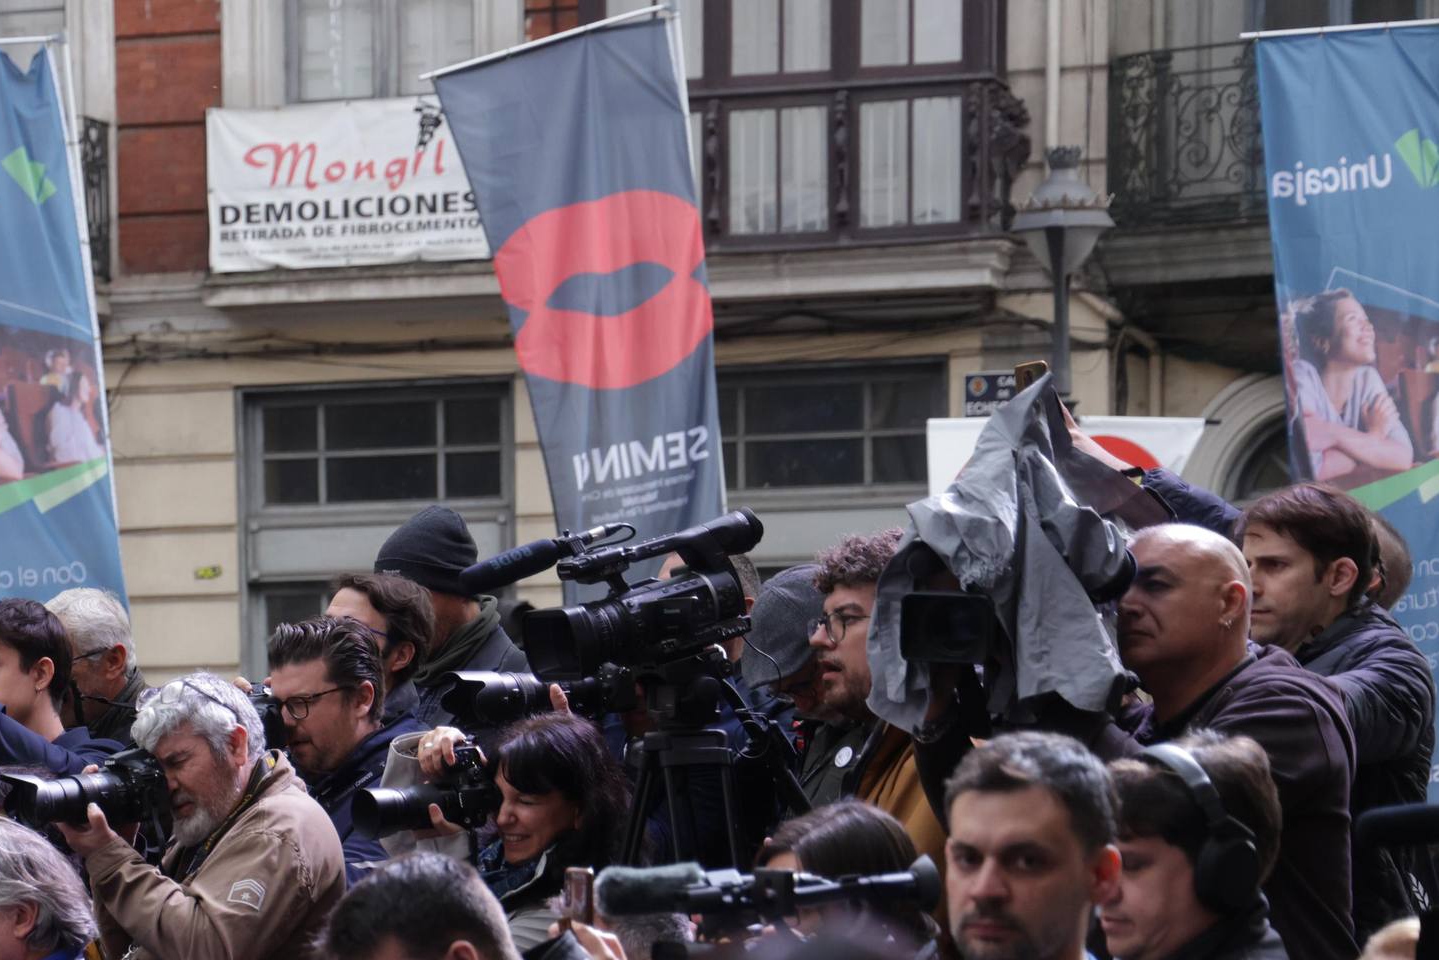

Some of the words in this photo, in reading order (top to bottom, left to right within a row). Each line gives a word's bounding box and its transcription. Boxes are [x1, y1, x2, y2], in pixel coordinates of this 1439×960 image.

[219, 190, 479, 226] DEMOLICIONES
[220, 223, 305, 242] RETIRADA
[312, 223, 334, 238] DE
[341, 217, 481, 237] FIBROCEMENTO
